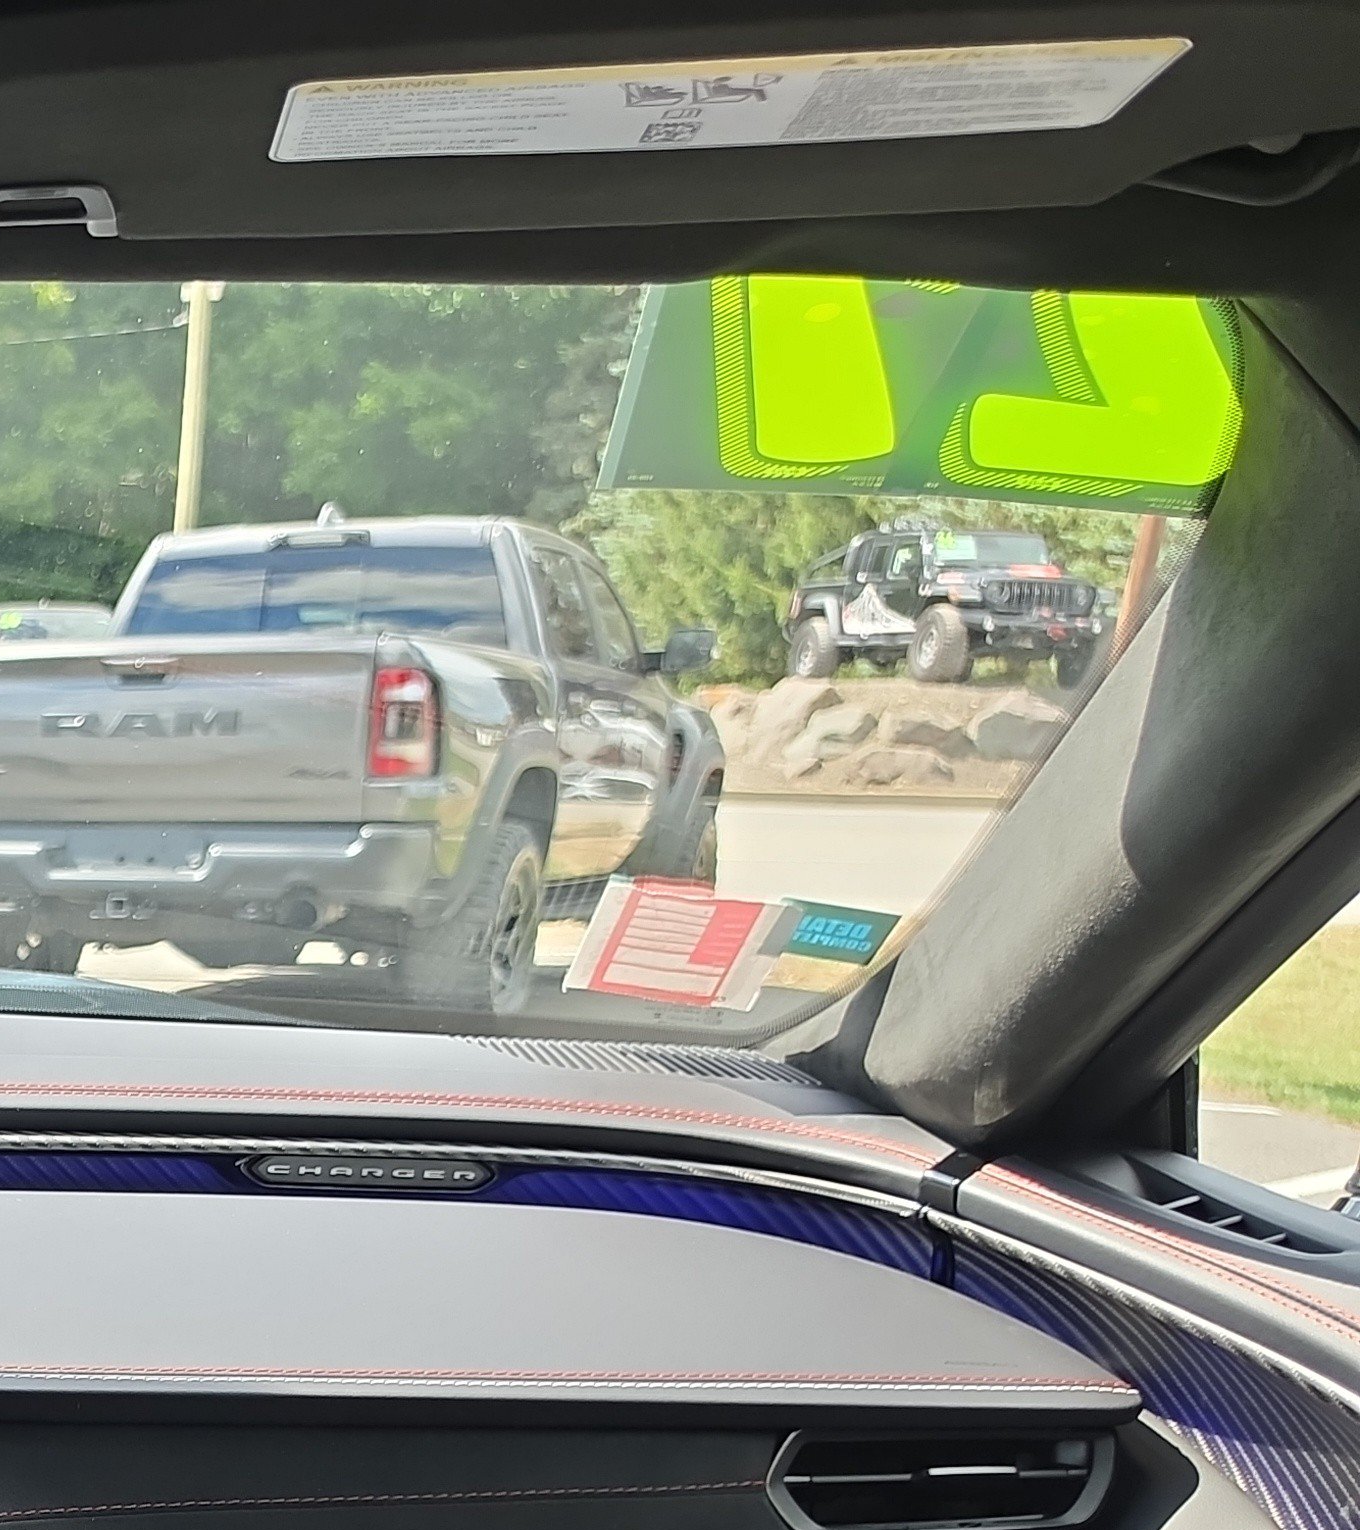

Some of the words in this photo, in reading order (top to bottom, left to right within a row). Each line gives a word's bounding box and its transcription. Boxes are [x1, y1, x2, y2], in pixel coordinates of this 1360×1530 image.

[346, 80, 469, 91] WARNING
[40, 710, 242, 737] RAM
[267, 1164, 476, 1180] CHARGER
